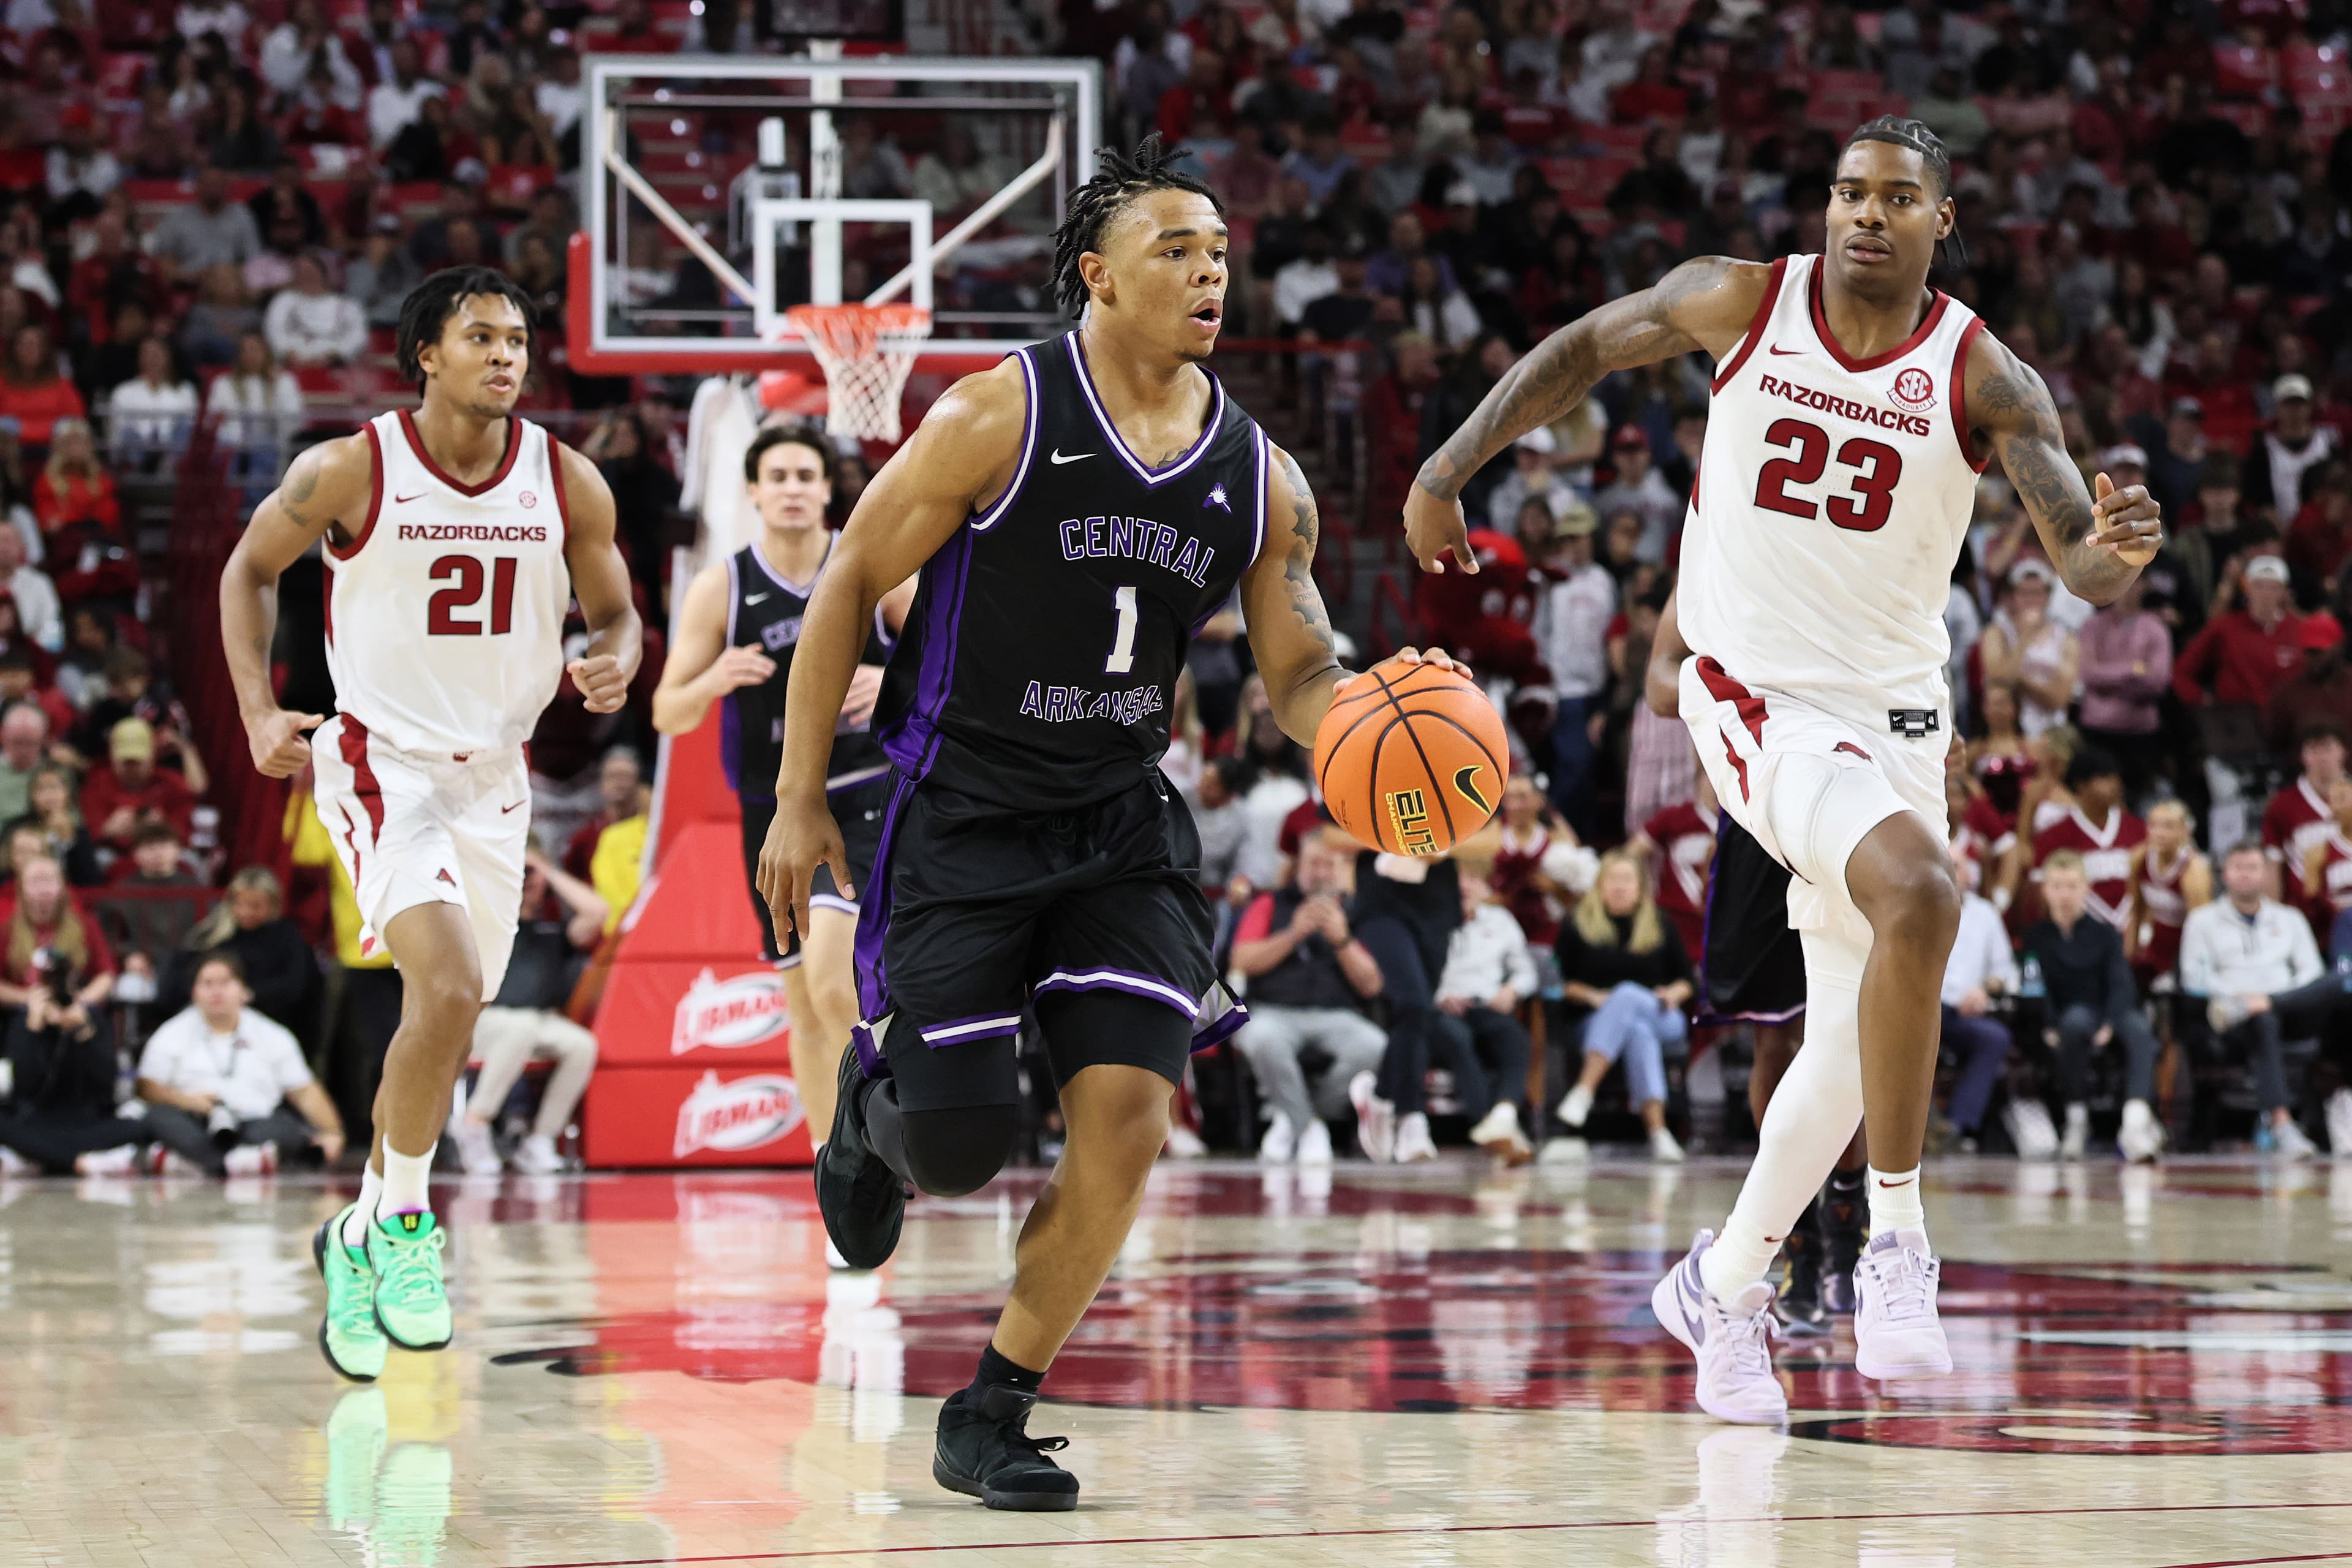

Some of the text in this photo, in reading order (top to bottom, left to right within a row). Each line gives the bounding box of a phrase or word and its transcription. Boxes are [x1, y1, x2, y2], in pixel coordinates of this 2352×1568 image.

[1759, 374, 1931, 437] RAZORBACKS
[1894, 396, 1927, 410] GRADUATE
[1899, 370, 1929, 400] SEC
[1754, 418, 1902, 532] 23
[398, 525, 546, 541] RAZORBACKS
[1060, 516, 1215, 588] CENTRAL
[428, 554, 517, 636] 21
[1104, 585, 1139, 674] 1
[1019, 680, 1163, 725] ARKANSAS
[1394, 788, 1438, 856] ELITE
